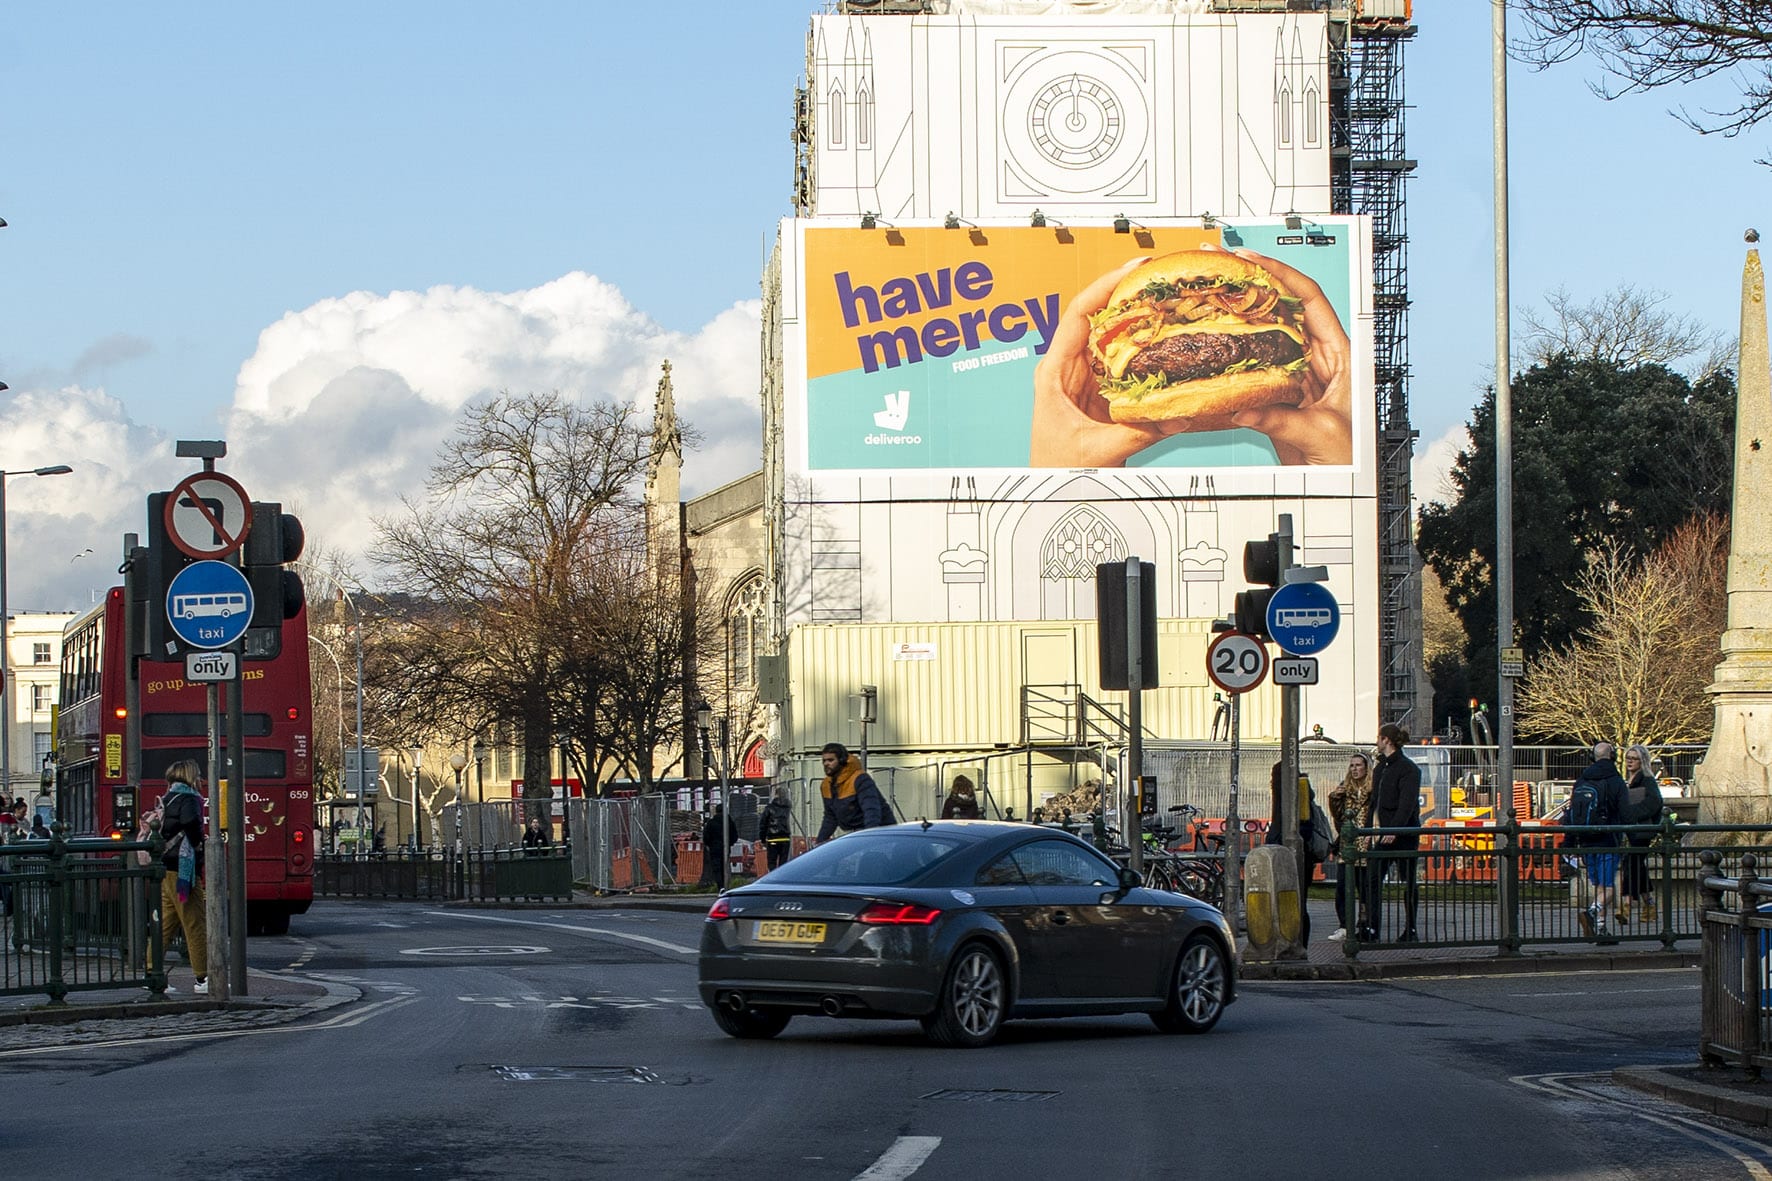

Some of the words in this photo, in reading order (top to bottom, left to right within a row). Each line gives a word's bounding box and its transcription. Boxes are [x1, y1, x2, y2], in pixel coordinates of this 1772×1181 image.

[834, 261, 994, 328] have
[857, 293, 1060, 374] mercy
[952, 357, 980, 374] FOOD
[980, 346, 1029, 367] FREEDOM
[864, 433, 922, 445] deliveroo
[198, 626, 225, 639] taxi
[1293, 635, 1315, 646] taxi
[193, 657, 230, 676] only
[1216, 648, 1260, 675] 20
[1280, 664, 1311, 678] only
[147, 681, 164, 694] go
[167, 680, 184, 691] up
[1503, 706, 1510, 715] 3
[289, 790, 309, 800] 659
